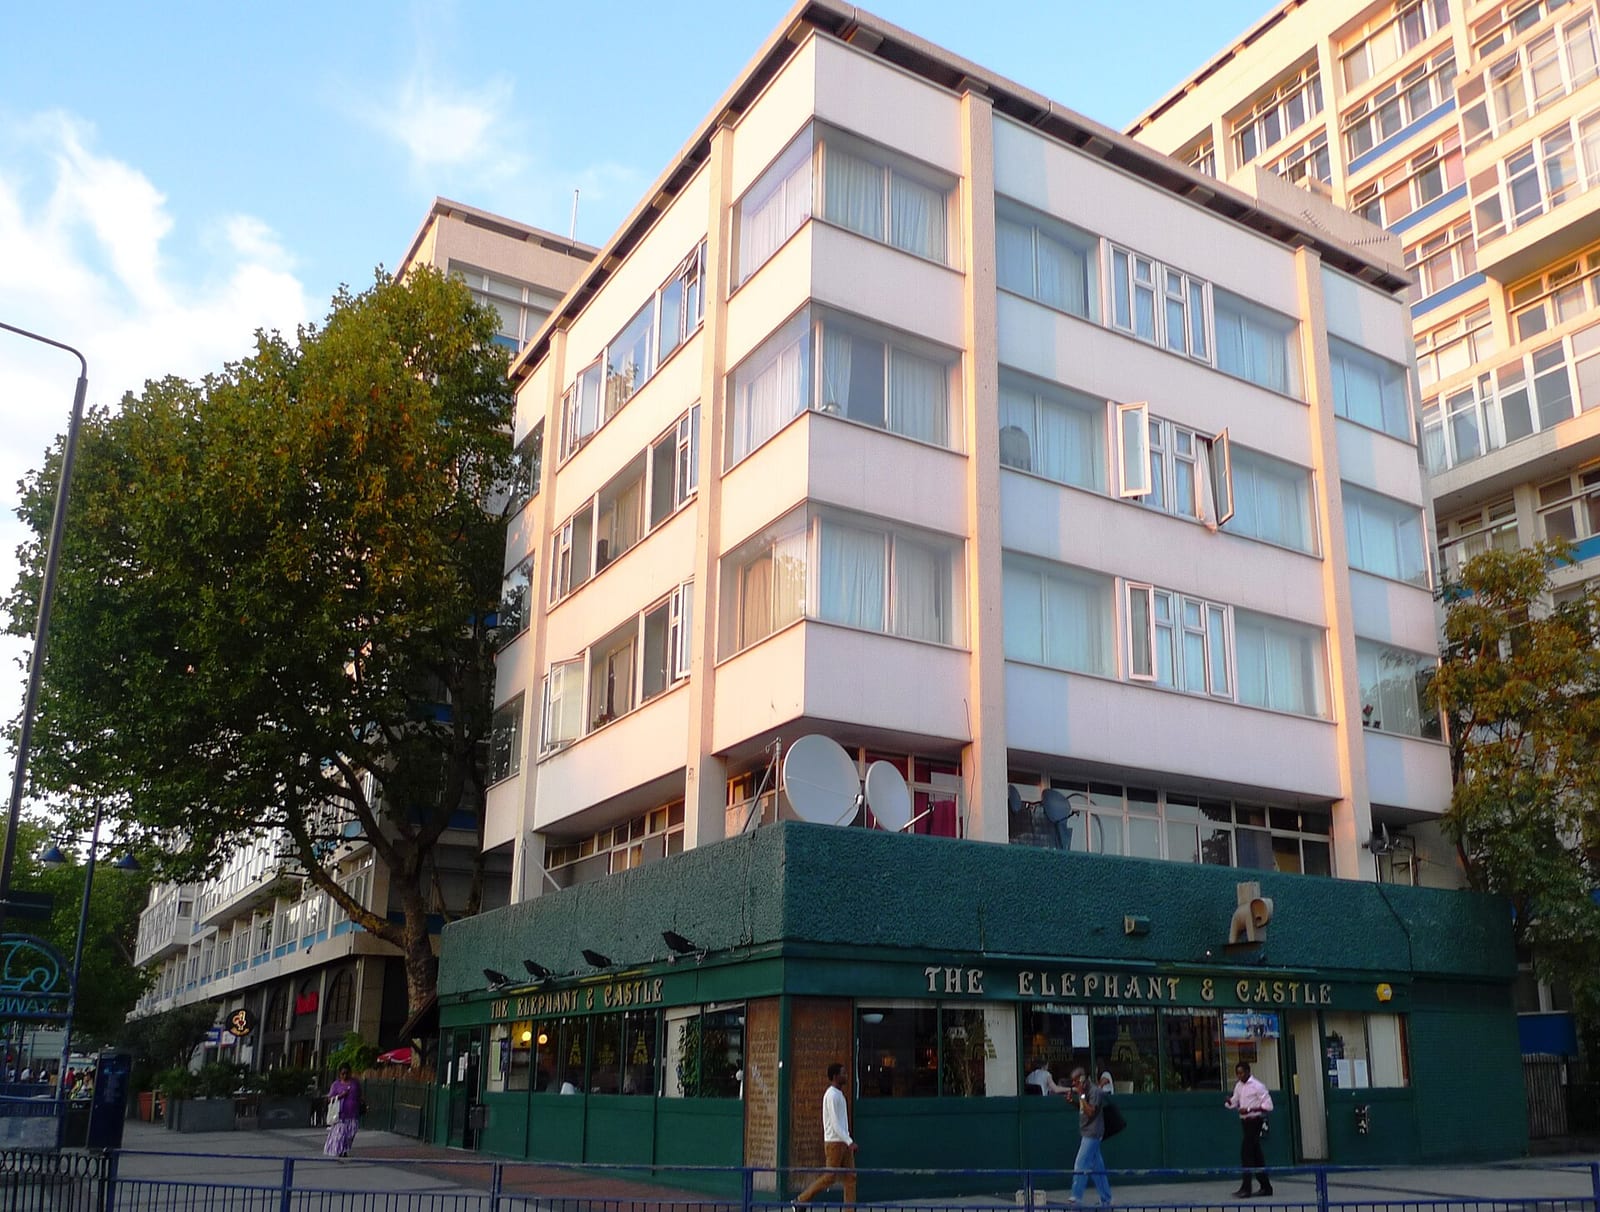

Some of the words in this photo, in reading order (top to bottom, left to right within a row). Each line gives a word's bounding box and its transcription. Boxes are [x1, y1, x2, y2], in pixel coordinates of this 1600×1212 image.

[491, 1000, 508, 1018] THE
[517, 990, 579, 1016] ELEPHANT
[585, 985, 594, 1010] &
[604, 979, 663, 1007] CASTLE
[924, 966, 984, 994] THE
[1017, 971, 1180, 1001] ELEPHANT
[1201, 977, 1215, 1001] &
[1236, 979, 1333, 1005] CASTLE
